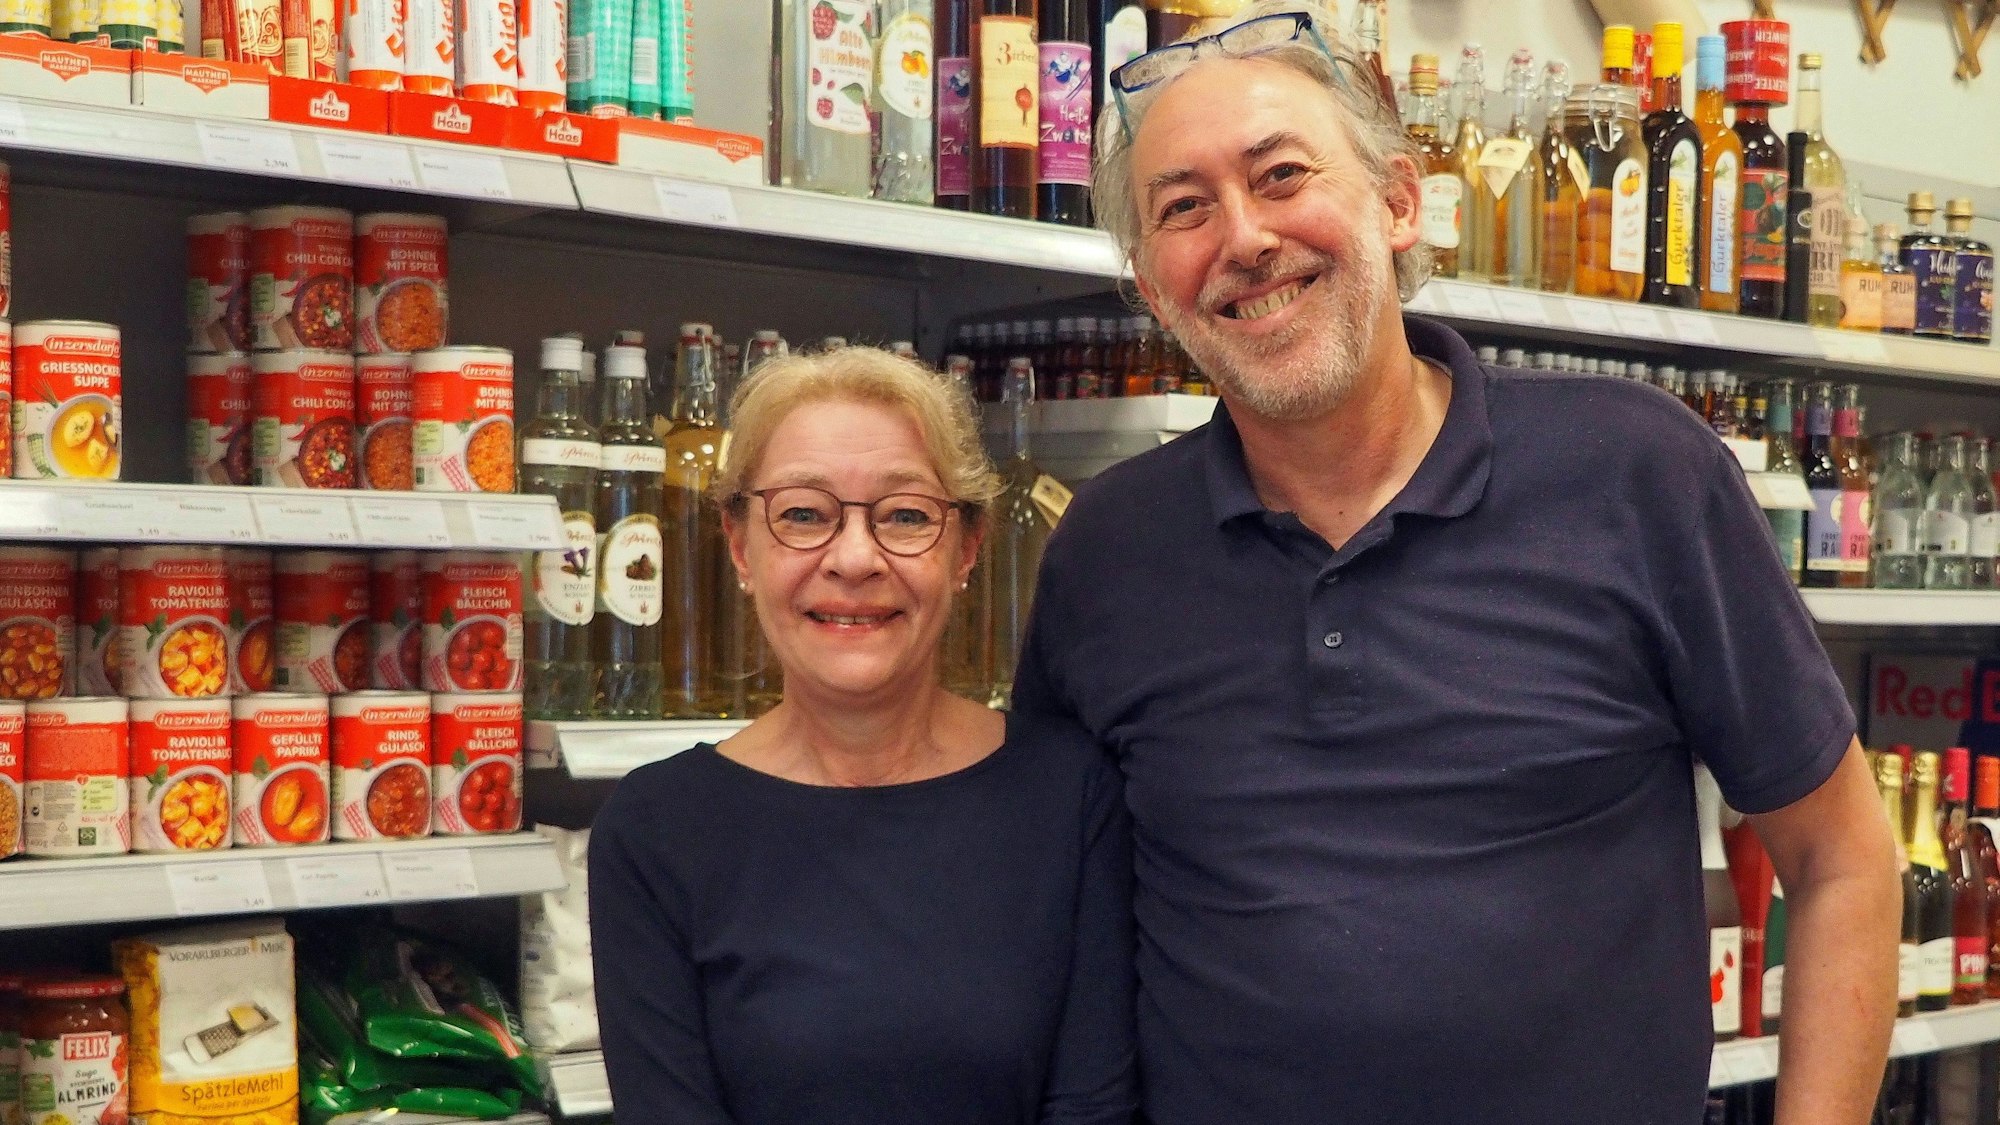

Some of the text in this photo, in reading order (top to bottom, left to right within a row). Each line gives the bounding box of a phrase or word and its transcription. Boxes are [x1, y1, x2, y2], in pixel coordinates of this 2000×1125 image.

[43, 54, 88, 67] MAUTNER
[185, 67, 228, 80] MAUTNER
[314, 102, 346, 119] Haas
[437, 116, 468, 131] Haas
[549, 129, 580, 144] Haas
[1669, 183, 1685, 266] Gurktaler
[1712, 193, 1728, 274] Gurktaler
[390, 249, 437, 261] BOHNEN
[74, 375, 110, 389] SUPPE
[476, 398, 495, 409] MIT
[168, 585, 214, 597] RAVIOLI
[463, 587, 507, 597] FLEISCH
[456, 596, 513, 609] BÄLLCHEN
[1875, 663, 1973, 721] Red
[475, 727, 516, 738] FLEISCH
[169, 735, 215, 748] RAVIOLI
[379, 740, 426, 753] GULASCH
[276, 746, 321, 758] PAPRIKA
[65, 1036, 109, 1059] FELIX
[57, 1081, 117, 1104] ALMRIND
[181, 1072, 284, 1106] SpätzleMehl
